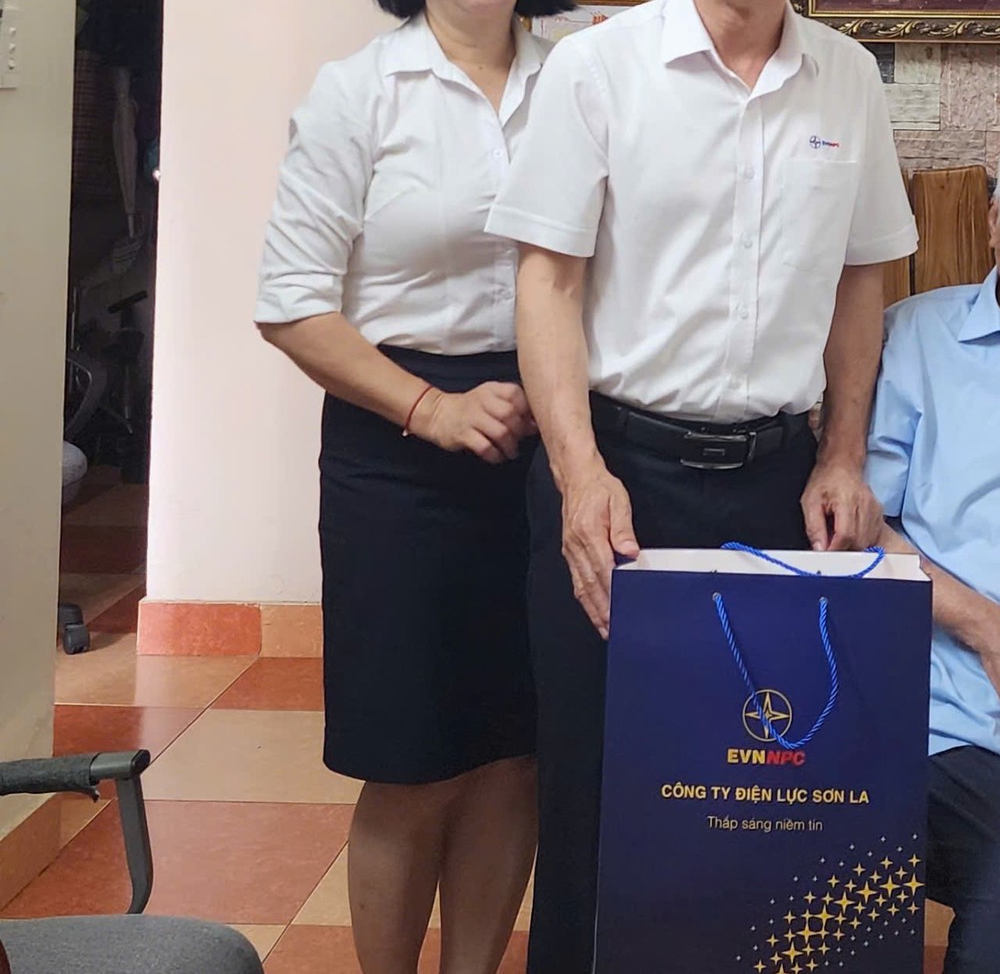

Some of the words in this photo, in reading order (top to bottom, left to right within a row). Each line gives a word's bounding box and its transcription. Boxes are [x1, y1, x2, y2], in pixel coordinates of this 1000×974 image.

[661, 782, 707, 799] CÔNG
[711, 786, 731, 800] TY
[735, 785, 772, 804] ĐIỆN
[777, 788, 807, 804] LỰC
[812, 789, 845, 804] SƠN
[850, 791, 870, 804] LA
[707, 815, 739, 830] Thấp
[742, 816, 772, 833] sáng
[775, 818, 805, 831] niềm
[808, 819, 823, 831] tin
